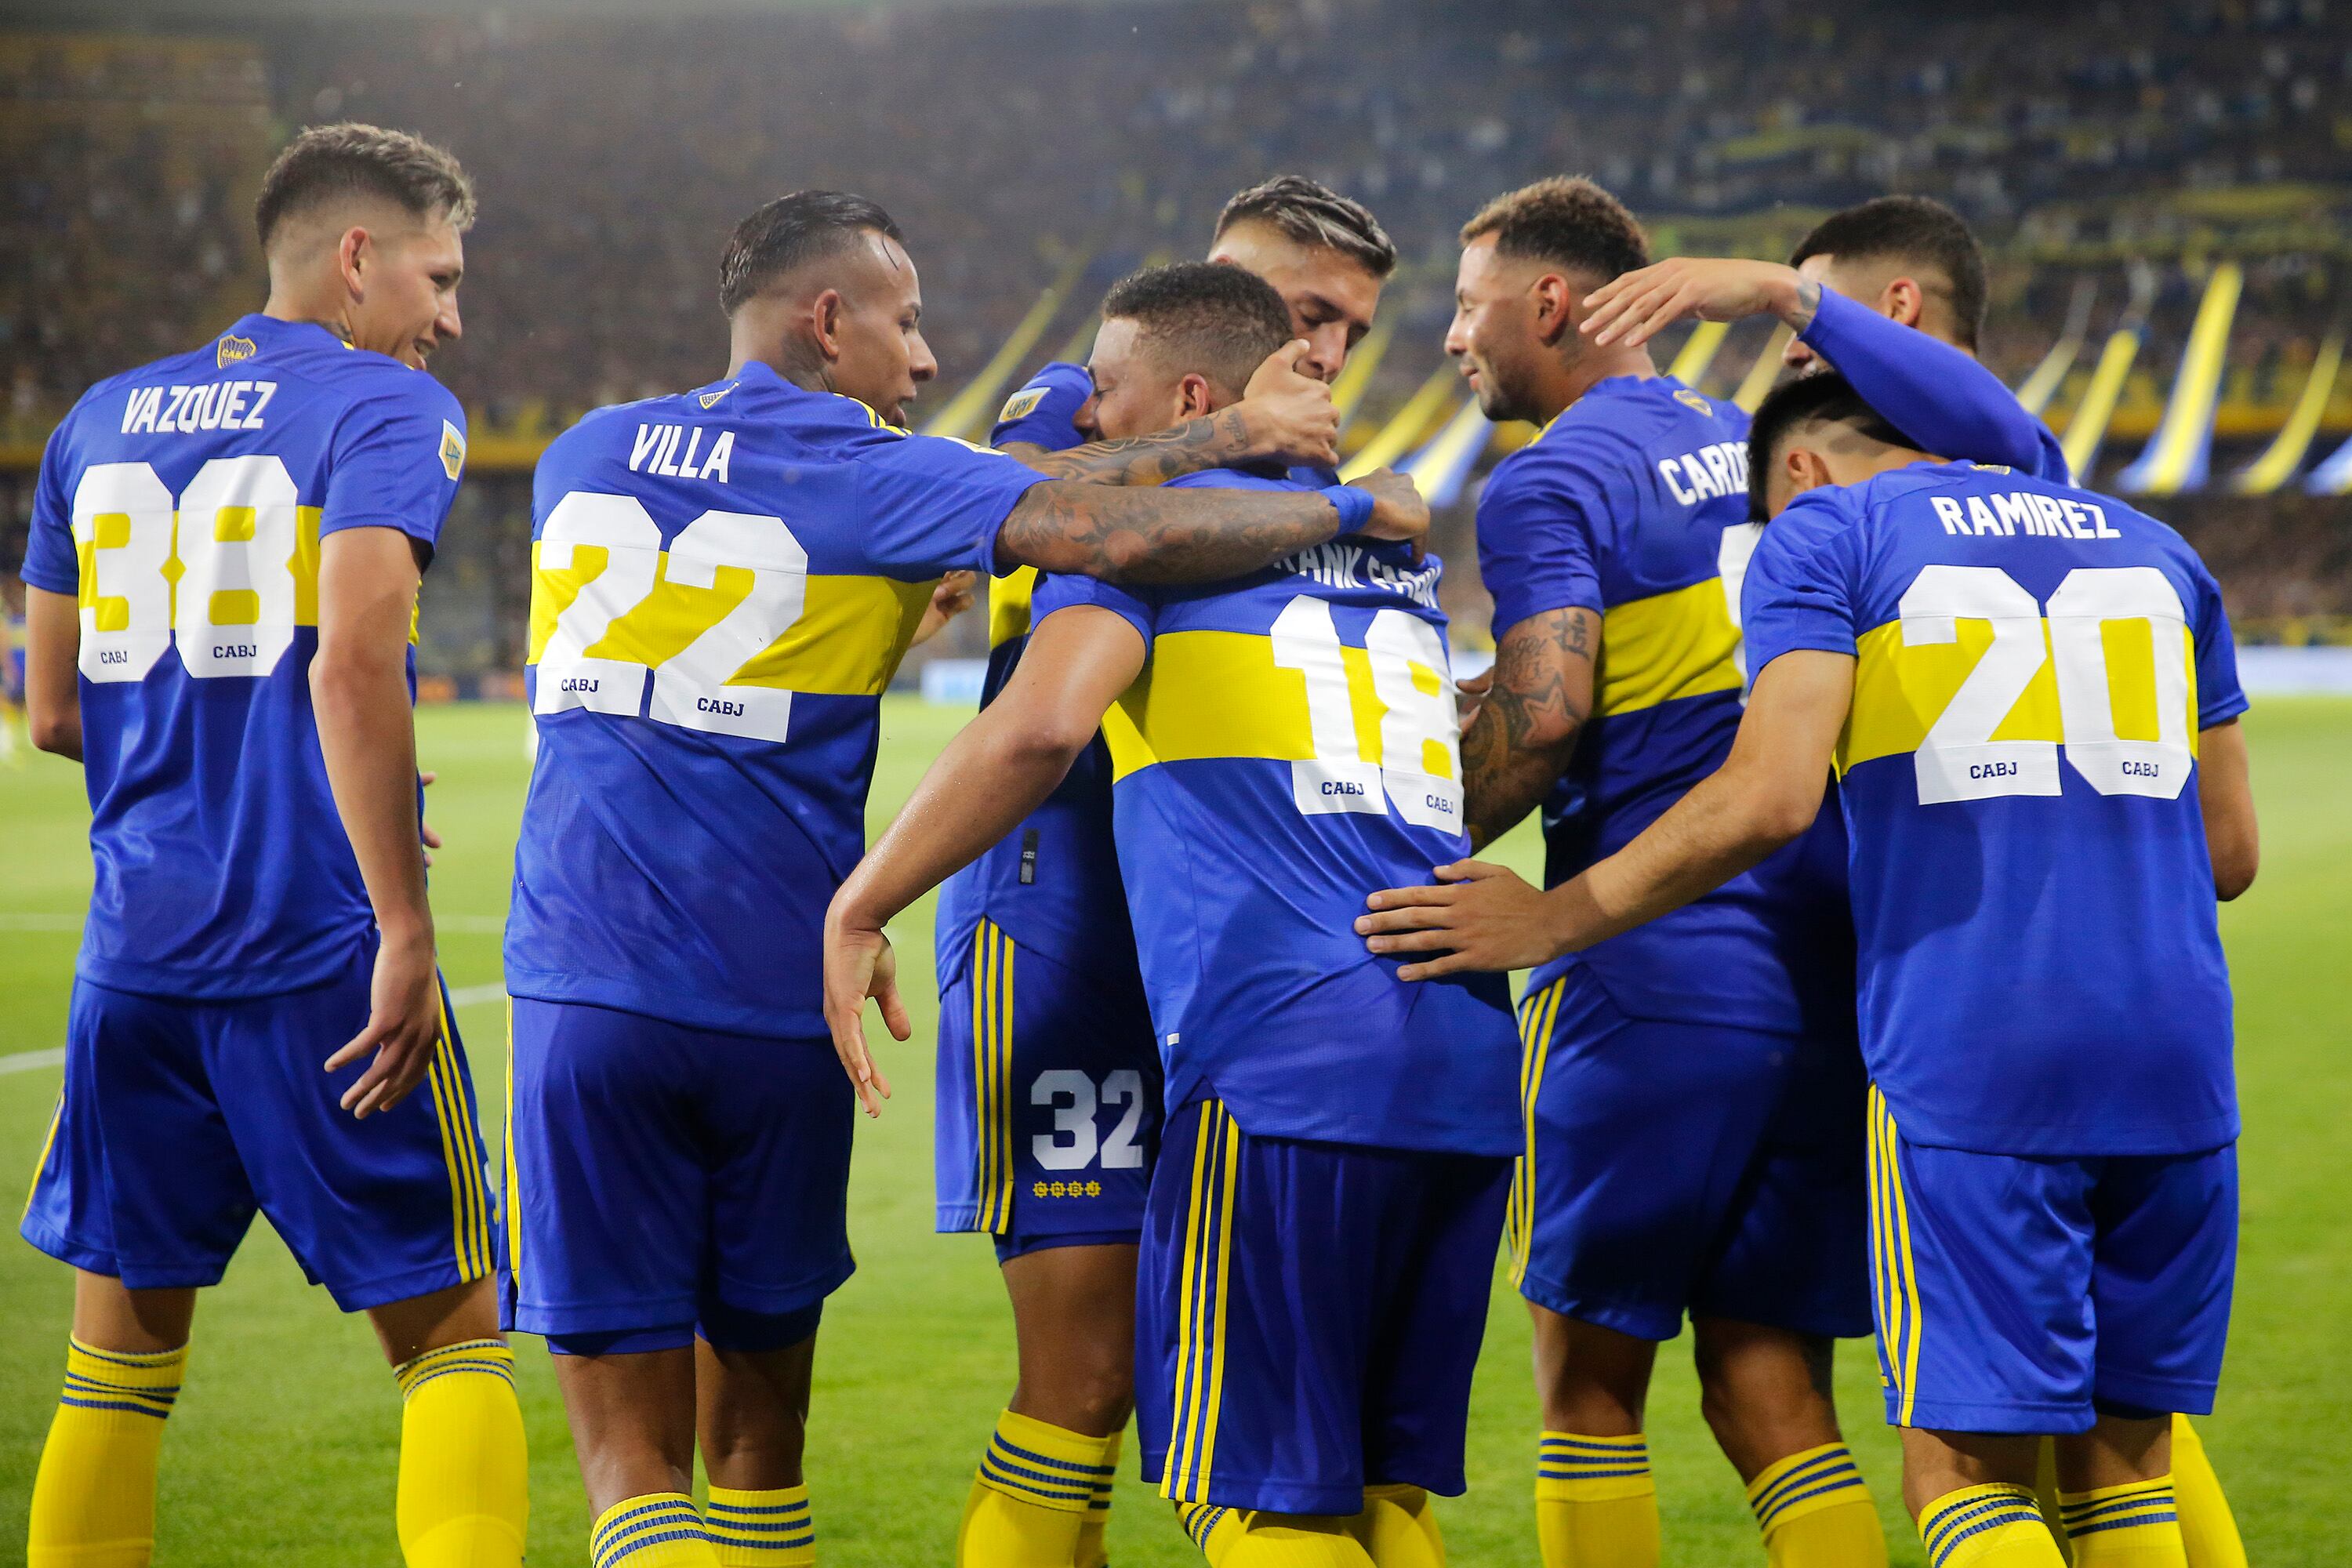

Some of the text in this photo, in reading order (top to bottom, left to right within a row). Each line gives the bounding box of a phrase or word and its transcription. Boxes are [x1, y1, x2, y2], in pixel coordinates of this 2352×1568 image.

[121, 380, 277, 434] VAZQUEZ
[628, 423, 735, 483] VILLA
[1930, 492, 2122, 540] RAMIREZ
[71, 455, 298, 684] 38
[533, 491, 808, 742] 22
[100, 651, 129, 664] CABJ
[212, 644, 257, 659] CABJ
[561, 677, 599, 693] CABJ
[1899, 564, 2194, 805] 20
[697, 697, 744, 717] CABJ
[1269, 593, 1465, 837] 18
[1969, 761, 2019, 780] CABJ
[2122, 760, 2159, 779] CABJ
[1321, 780, 1364, 797] CABJ
[1425, 794, 1454, 814] CABJ
[1031, 1069, 1144, 1171] 32
